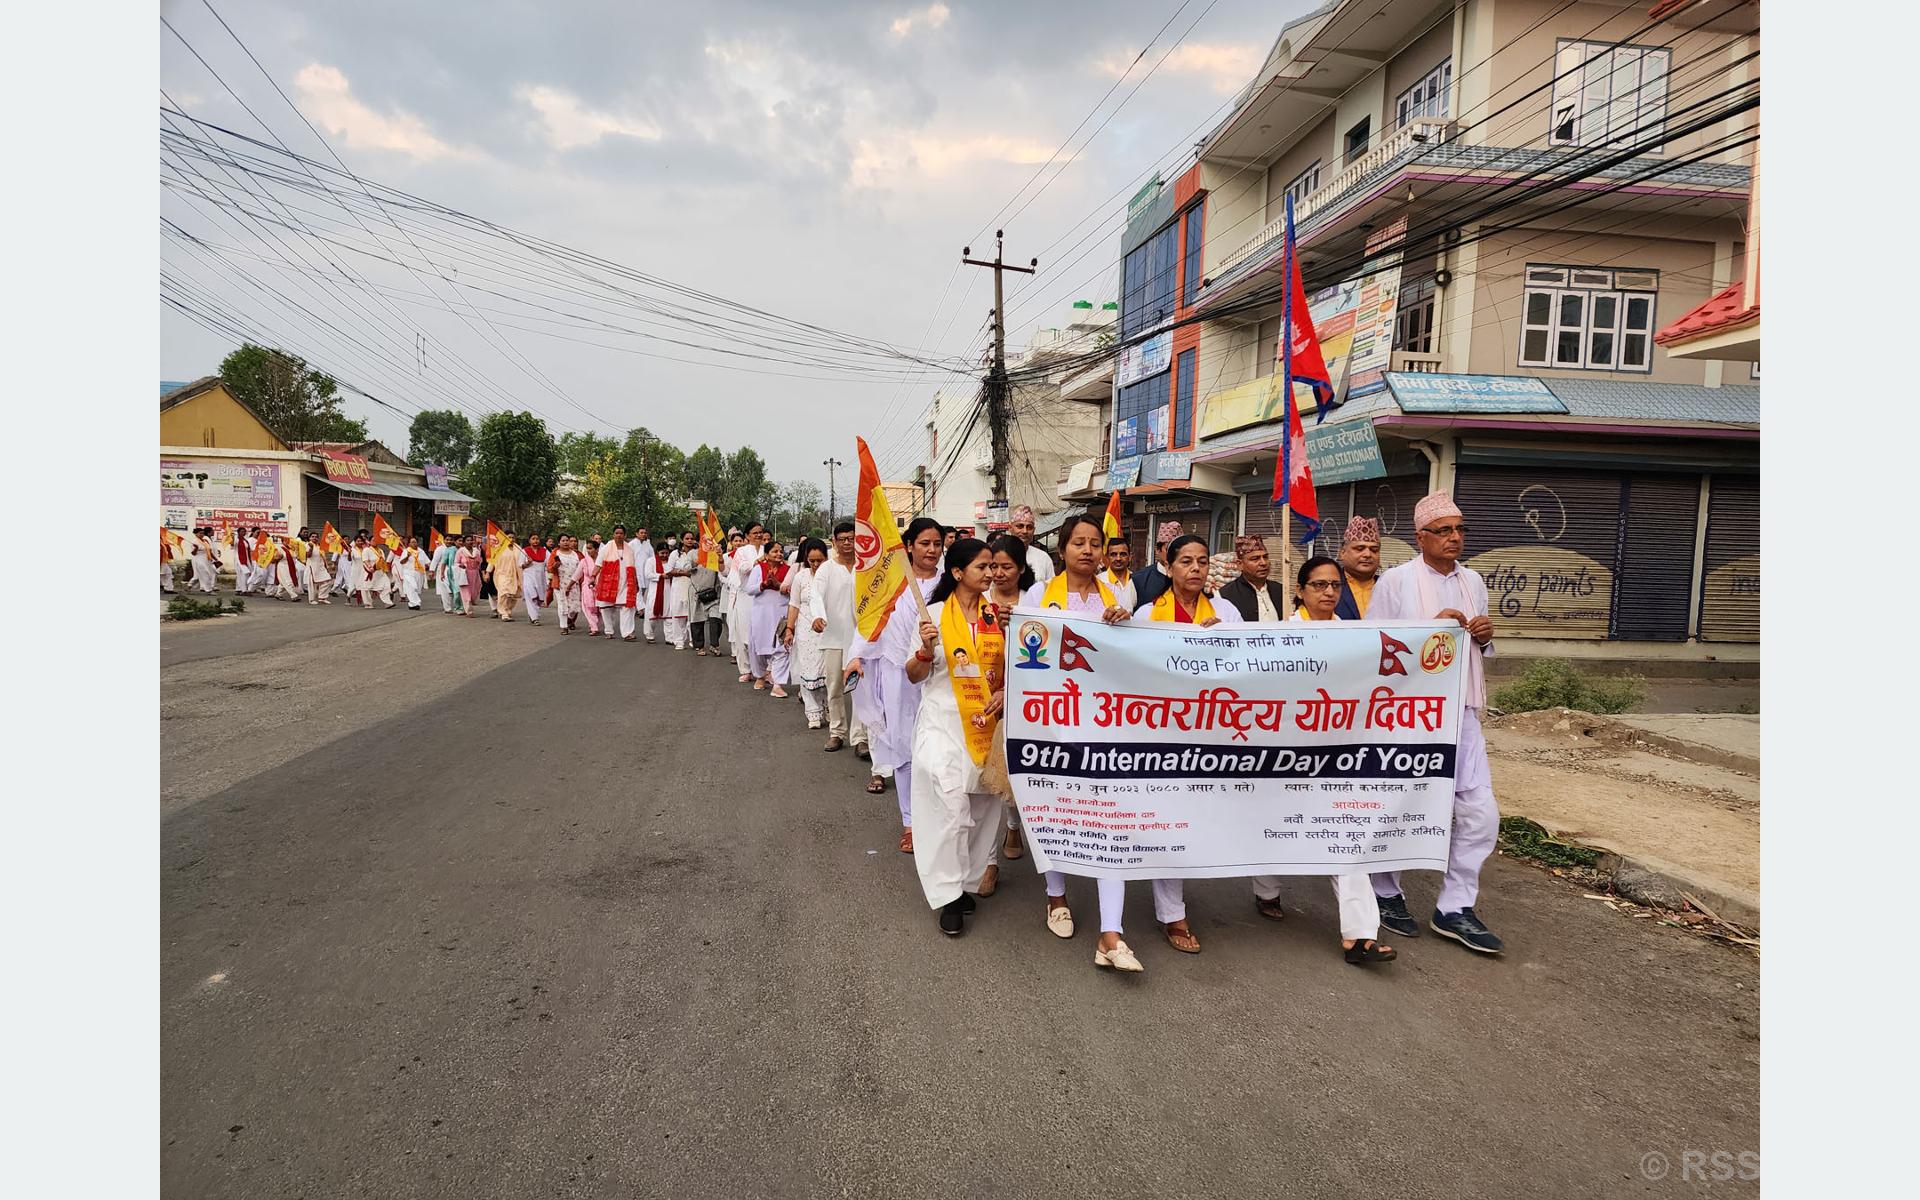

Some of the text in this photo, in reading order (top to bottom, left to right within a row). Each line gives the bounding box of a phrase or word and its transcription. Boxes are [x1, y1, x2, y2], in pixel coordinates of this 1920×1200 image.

[1322, 453, 1335, 469] AND
[1335, 445, 1379, 466] STATIONARY
[247, 465, 273, 478] फोटो
[349, 457, 370, 480] फोटो
[1532, 566, 1596, 613] paints
[1183, 633, 1305, 649] मानवताका लागि योग
[1166, 655, 1328, 676] (Yoga For Humanity)
[1295, 687, 1360, 732] योग
[1365, 685, 1446, 732] दिवस
[1020, 743, 1071, 769] 9th
[1080, 746, 1267, 772] International
[1272, 750, 1329, 777] Day
[1336, 747, 1369, 771] of
[1376, 747, 1445, 777] Yoga
[1066, 782, 1081, 791] २१
[1089, 784, 1108, 796] जुन
[1113, 785, 1139, 793] २०२३
[1146, 783, 1180, 794] (२०८०
[1186, 784, 1214, 793] असार
[1220, 784, 1226, 793] ६
[1234, 781, 1255, 794] गते)
[1378, 813, 1398, 825] योग
[1402, 812, 1425, 823] दिवस
[1263, 825, 1446, 842] जिल्ला स्तरीय मूल समारोह समिति
